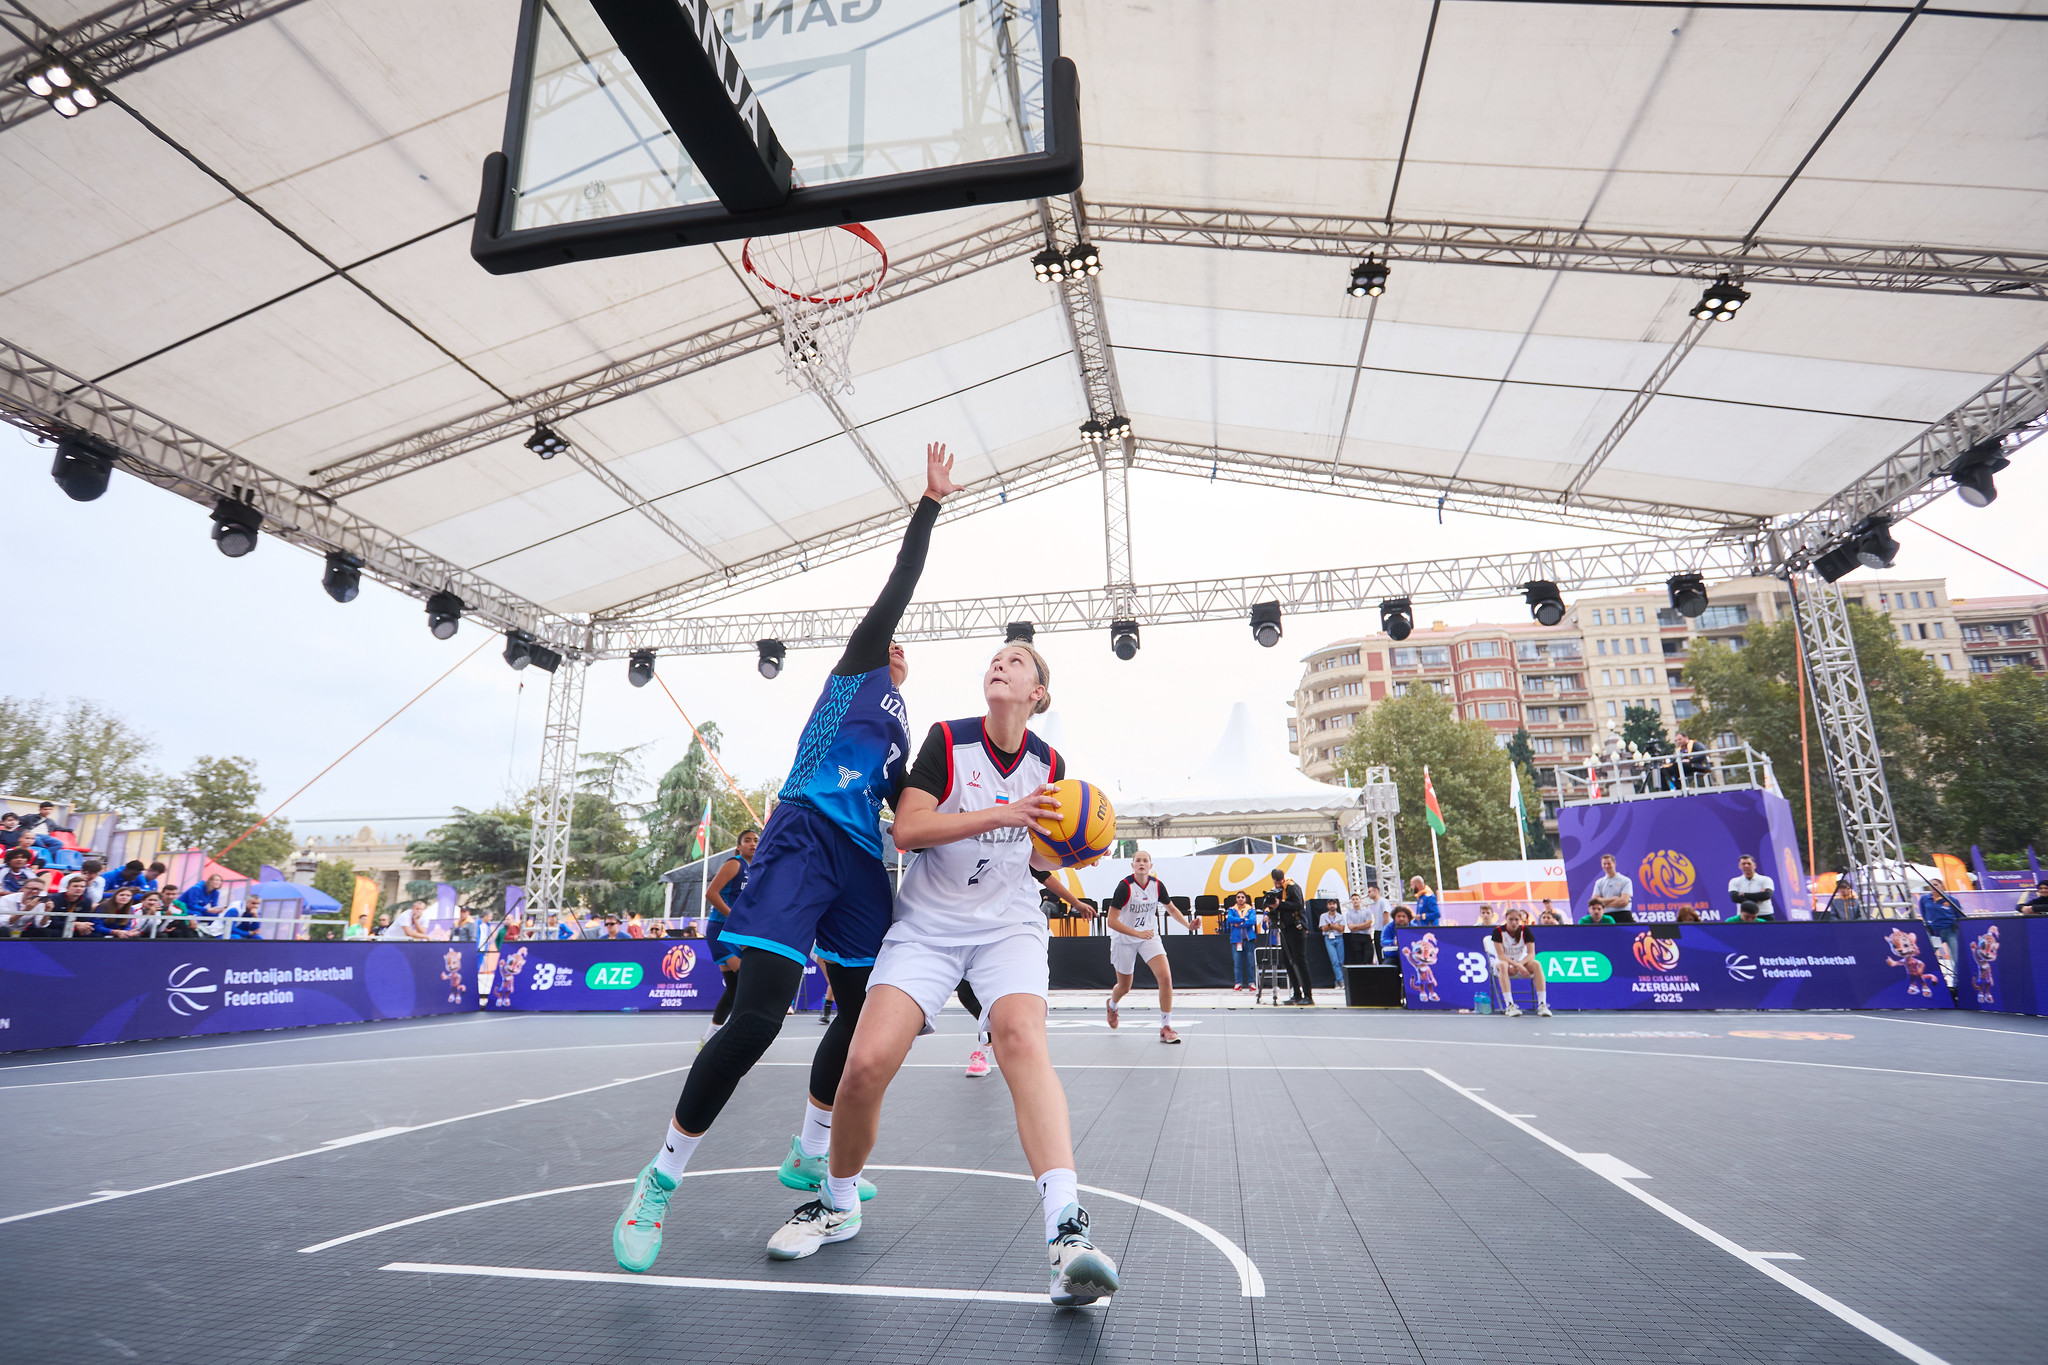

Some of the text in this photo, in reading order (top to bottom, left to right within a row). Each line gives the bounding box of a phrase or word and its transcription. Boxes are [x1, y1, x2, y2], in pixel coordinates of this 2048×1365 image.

[967, 858, 991, 886] 2
[1134, 916, 1146, 928] 24
[1547, 956, 1600, 977] AZE
[1759, 955, 1857, 967] Azerbaijan Basketball
[224, 966, 353, 985] Azerbaijan Basketball
[556, 967, 574, 975] Baku
[594, 967, 635, 985] AZE
[1761, 968, 1813, 978] Federation
[1631, 982, 1701, 992] AZERBAIJAN
[224, 989, 294, 1007] Federation
[648, 989, 699, 998] AZERBAIJAN
[1653, 992, 1684, 1003] 2025
[660, 998, 683, 1007] 2025
